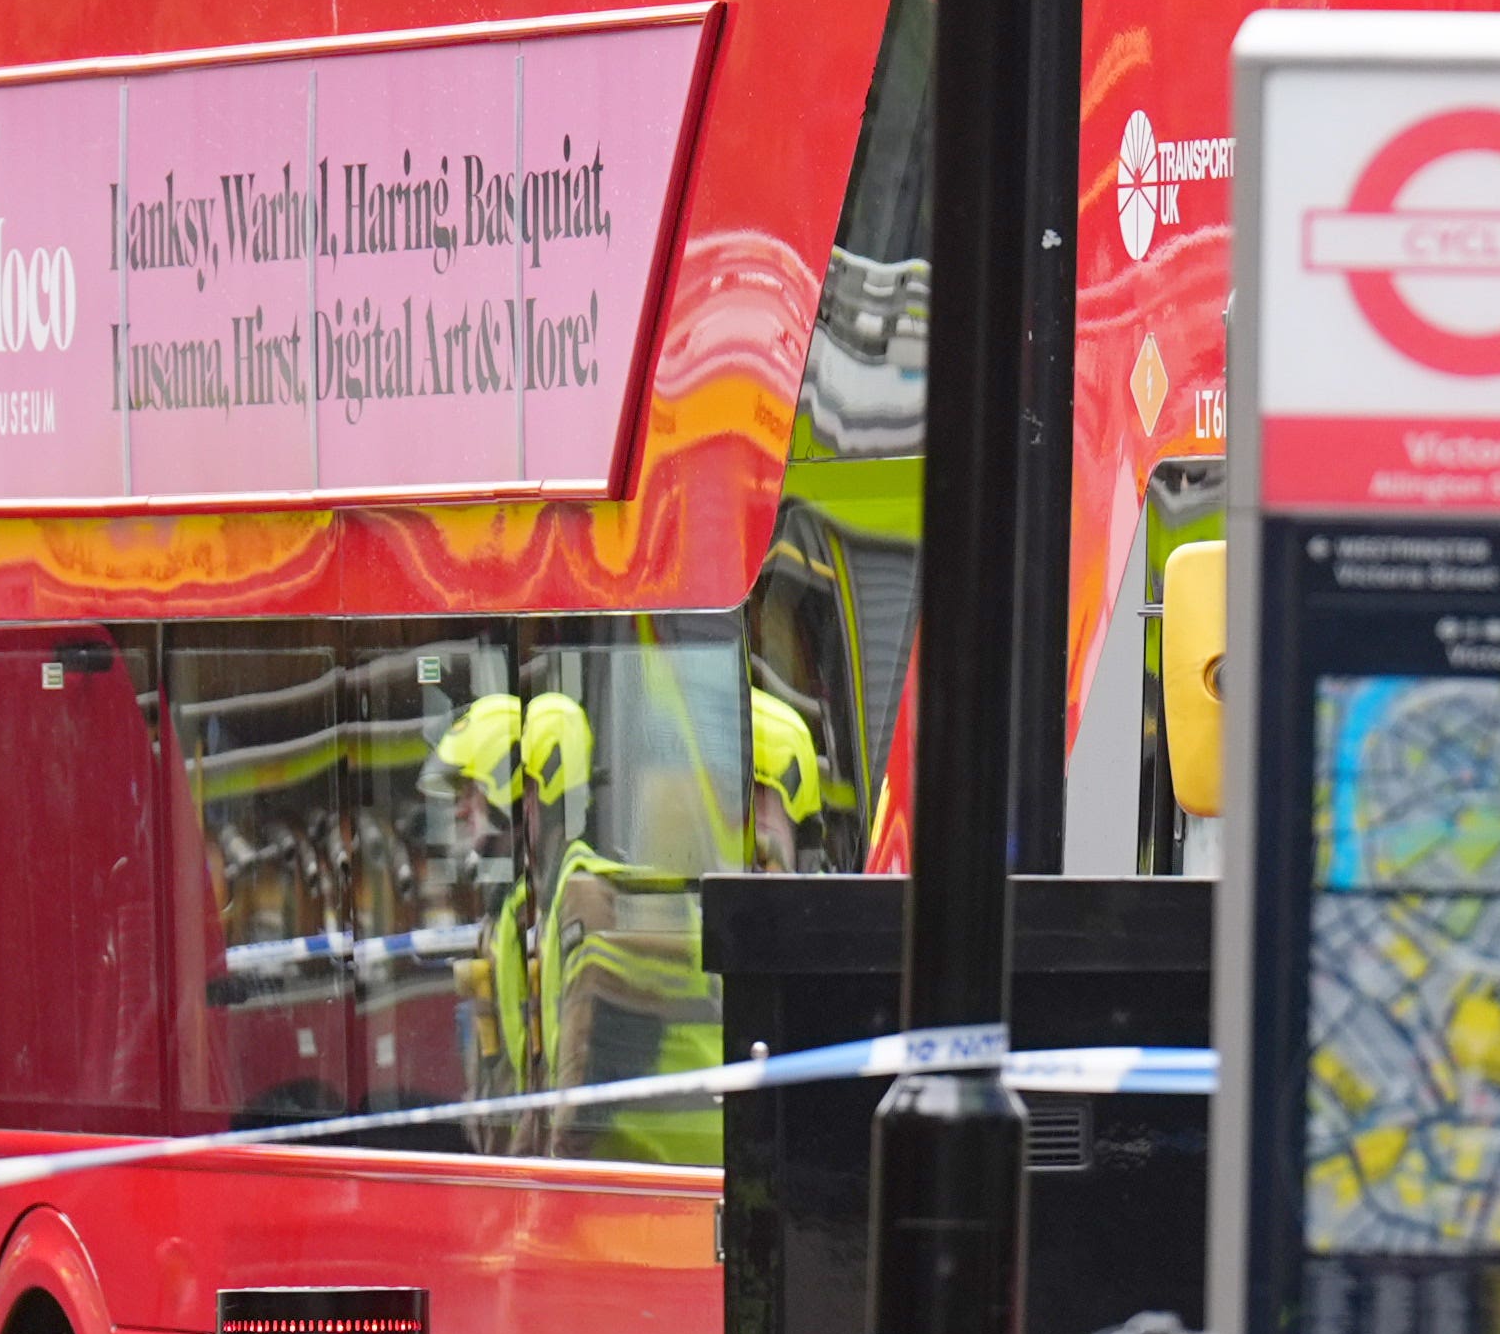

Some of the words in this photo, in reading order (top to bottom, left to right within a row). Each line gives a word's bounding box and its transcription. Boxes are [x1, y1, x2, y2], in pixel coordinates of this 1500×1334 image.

[1157, 137, 1237, 182] TRANSPORT
[220, 154, 338, 274] Warhol,
[342, 147, 459, 275] Haring,
[462, 132, 612, 269] Basquiat,
[1158, 183, 1181, 225] UK
[231, 303, 308, 422] Hirst,
[313, 294, 414, 426] Digital
[417, 293, 473, 396] Art
[474, 298, 502, 394] &
[503, 287, 599, 392] More!
[1195, 389, 1227, 439] LT6
